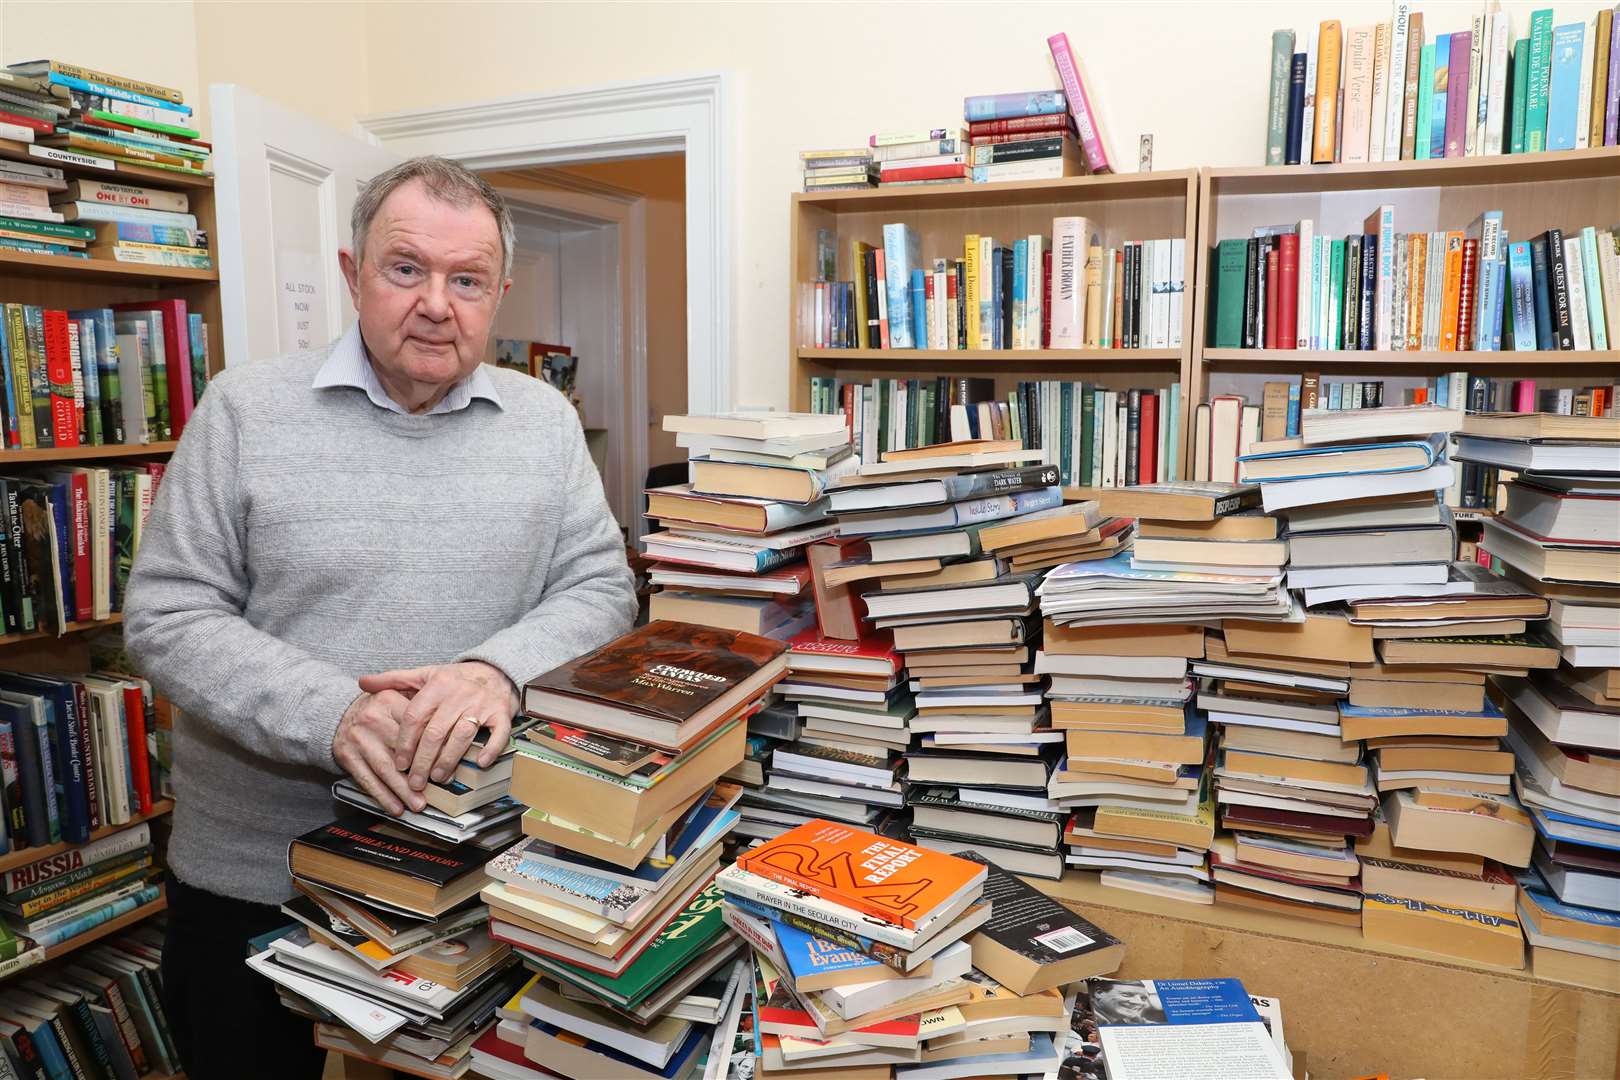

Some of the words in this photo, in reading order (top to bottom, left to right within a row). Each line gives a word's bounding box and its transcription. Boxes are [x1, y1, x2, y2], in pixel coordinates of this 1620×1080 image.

[1396, 5, 1407, 36] SHOUT
[1532, 16, 1544, 52] WALTER
[1352, 32, 1368, 71] Popular
[1531, 56, 1540, 68] DE
[88, 73, 105, 81] The
[107, 75, 120, 86] Eye
[132, 82, 145, 91] the
[145, 86, 166, 96] Wind
[88, 83, 104, 92] The
[1531, 71, 1539, 82] LA
[1540, 65, 1549, 97] POEMS
[1351, 75, 1364, 102] Verse
[1528, 83, 1539, 110] MARE
[47, 151, 97, 165] COUNTRYSIDE
[96, 192, 116, 202] ONE
[131, 196, 149, 205] ONE
[1384, 211, 1392, 224] THE
[1062, 235, 1075, 267] FATHER
[1383, 226, 1392, 254] JUNGLE
[966, 248, 975, 273] Lorna
[1382, 256, 1391, 276] BOOK
[285, 282, 296, 292] ALL
[298, 283, 315, 294] STOCK
[966, 275, 976, 301] Doone
[1060, 269, 1074, 300] BROWN
[1554, 263, 1564, 290] QUEST
[294, 302, 310, 312] NOW
[1558, 292, 1566, 308] FOR
[35, 310, 45, 342] JAMES
[1560, 310, 1568, 327] KIM
[68, 323, 80, 369] DESMOND
[38, 344, 49, 387] HERRIOT
[72, 371, 84, 409] MORRIS
[56, 401, 66, 441] GOULD
[994, 478, 1007, 487] DARK
[1008, 476, 1022, 486] WATER
[8, 491, 19, 515] Tarka
[75, 488, 83, 499] The
[10, 515, 20, 526] the
[76, 499, 84, 522] Making
[11, 525, 22, 548] Otter
[763, 552, 778, 568] John
[649, 668, 702, 682] CANVAS
[656, 664, 727, 682] CROWDED
[632, 678, 654, 687] Max
[657, 683, 695, 696] Warren
[921, 795, 950, 805] with
[1001, 806, 1056, 821] Through
[326, 826, 346, 837] THE
[350, 833, 383, 850] BIBLE
[385, 843, 411, 856] AND
[413, 849, 464, 868] HISTORY
[860, 846, 909, 871] FINAL
[861, 841, 890, 856] THE
[12, 850, 83, 889] RUSSIA
[864, 849, 923, 884] REPORT
[30, 879, 68, 897] Mongoose
[70, 869, 94, 883] Watch
[784, 877, 798, 885] FINAL
[800, 882, 820, 894] REPORT
[757, 892, 783, 906] PRAYER
[784, 900, 791, 909] IN
[793, 903, 806, 914] THE
[807, 908, 840, 924] SECULAR
[841, 919, 858, 931] CITY
[1377, 893, 1425, 911] Plass
[1433, 906, 1500, 926] Adrian
[809, 952, 865, 967] Evang
